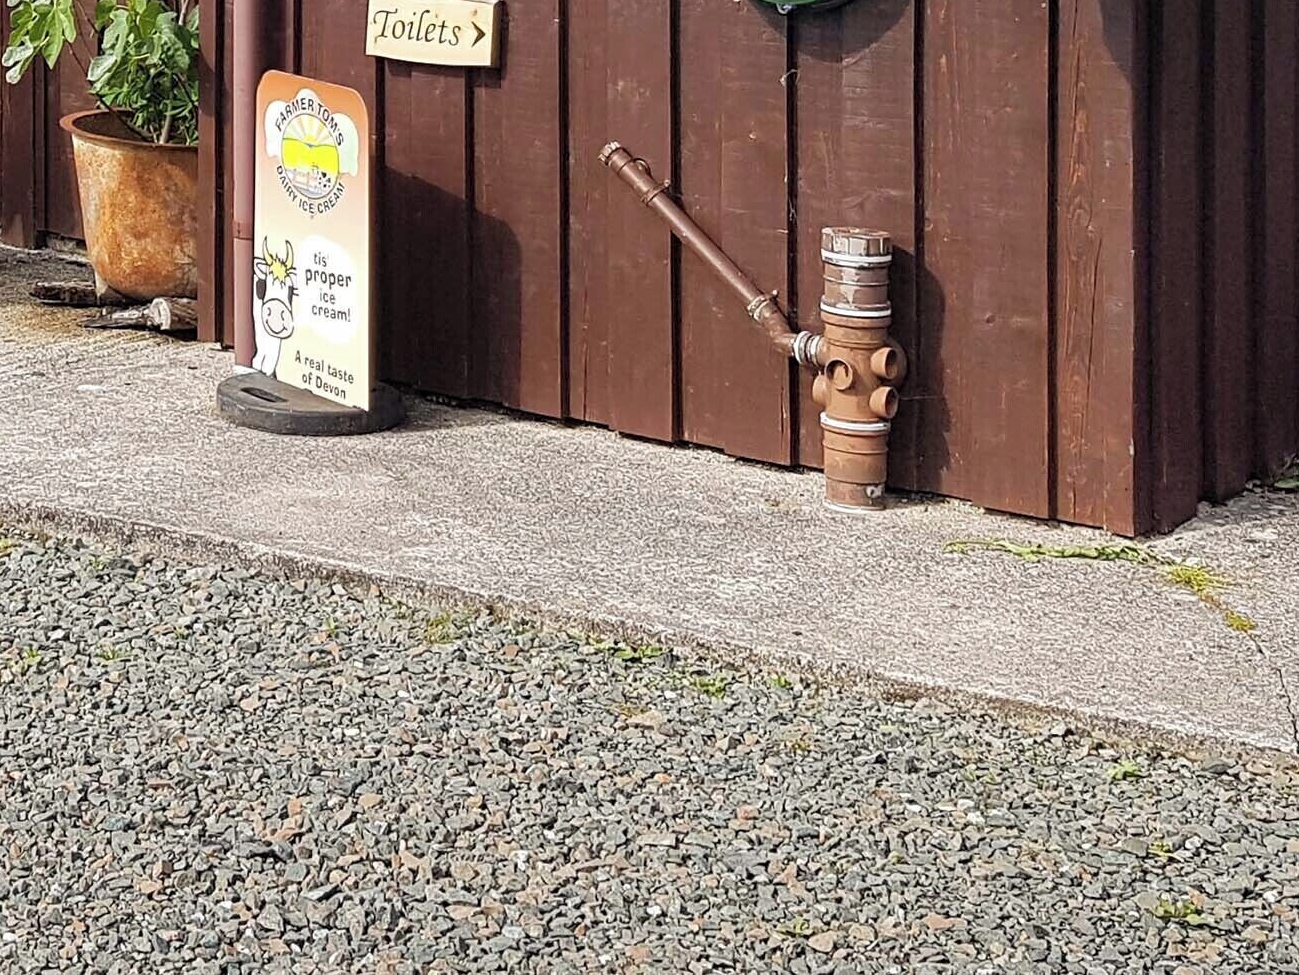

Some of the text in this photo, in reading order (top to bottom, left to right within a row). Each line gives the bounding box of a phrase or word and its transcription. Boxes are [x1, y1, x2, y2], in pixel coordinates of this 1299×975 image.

[373, 8, 461, 46] Toilets
[274, 97, 345, 147] FARMER TOM'S
[276, 165, 345, 214] DAIRY ICE CREAM
[305, 268, 352, 290] proper
[319, 288, 336, 305] ice
[311, 304, 351, 323] cream!
[295, 350, 354, 384] A real taste
[301, 373, 347, 400] of Devon
